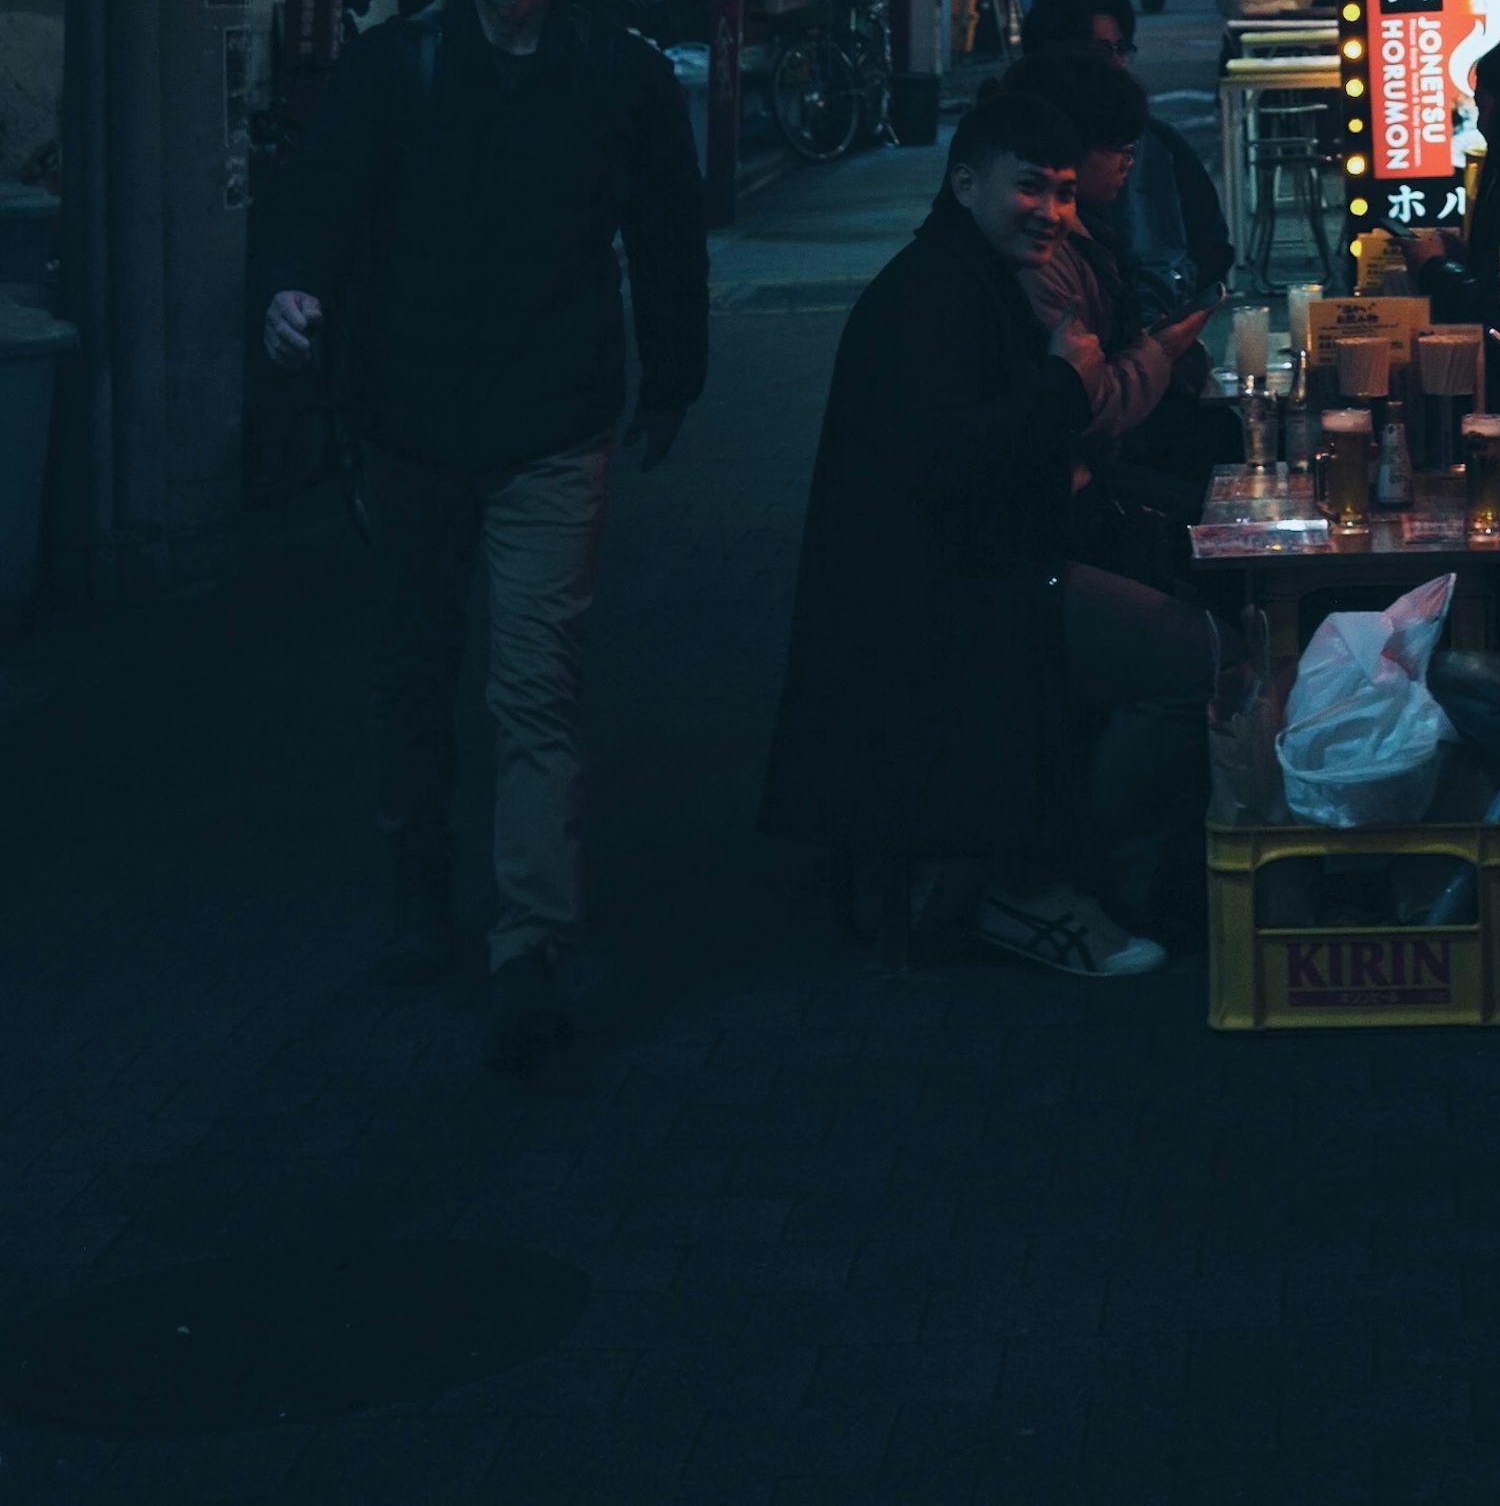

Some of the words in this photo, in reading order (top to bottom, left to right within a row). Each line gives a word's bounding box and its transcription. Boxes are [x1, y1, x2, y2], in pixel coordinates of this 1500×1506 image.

[1380, 19, 1410, 170] HORUMON
[1417, 16, 1446, 144] JONETSU
[1287, 940, 1450, 988] KIRIN
